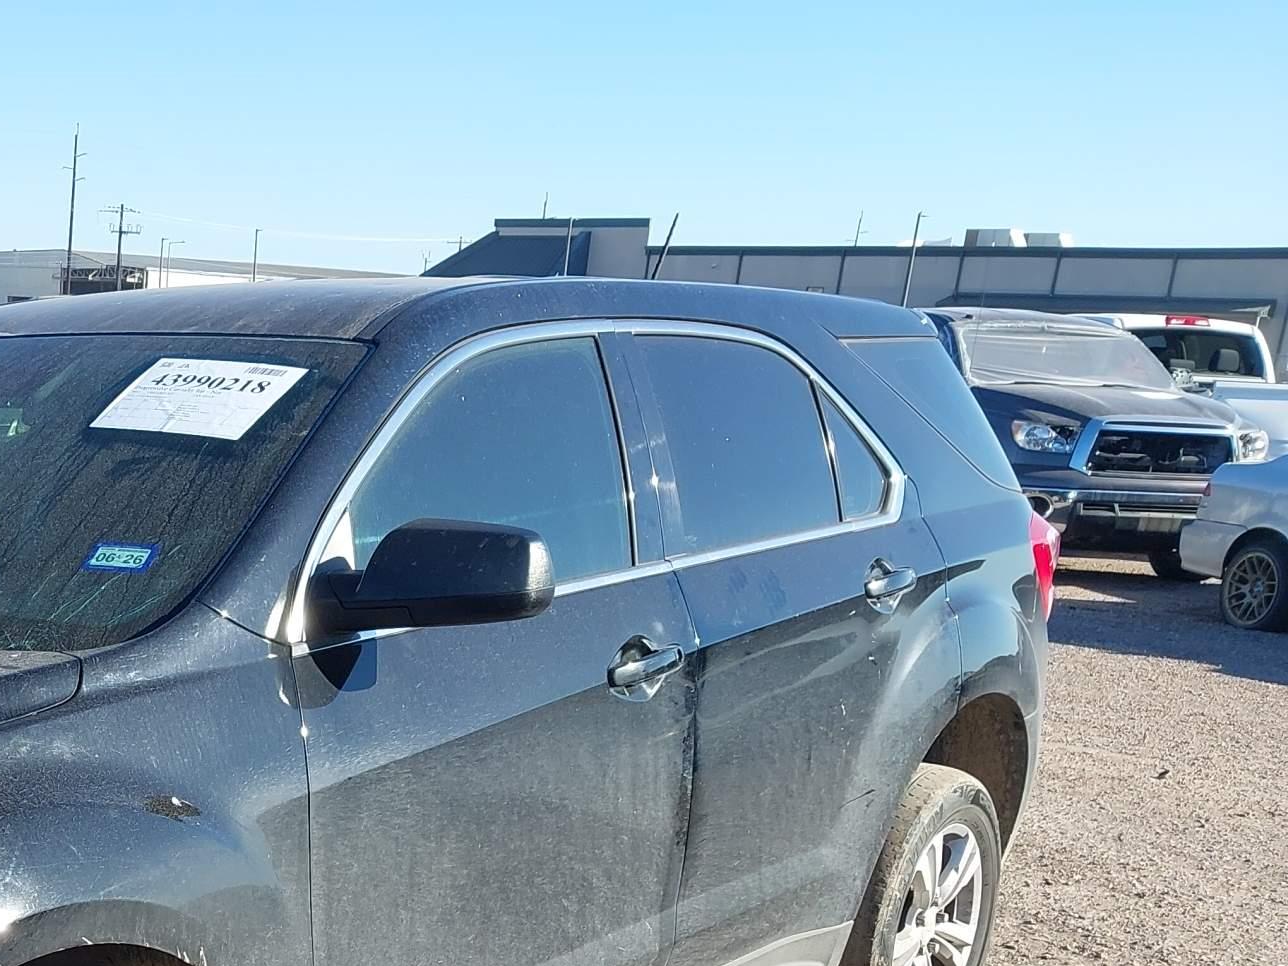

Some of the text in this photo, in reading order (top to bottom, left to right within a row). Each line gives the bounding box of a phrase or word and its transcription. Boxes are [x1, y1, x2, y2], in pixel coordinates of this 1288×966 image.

[152, 373, 271, 393] 43990218
[95, 552, 145, 565] 06 26
